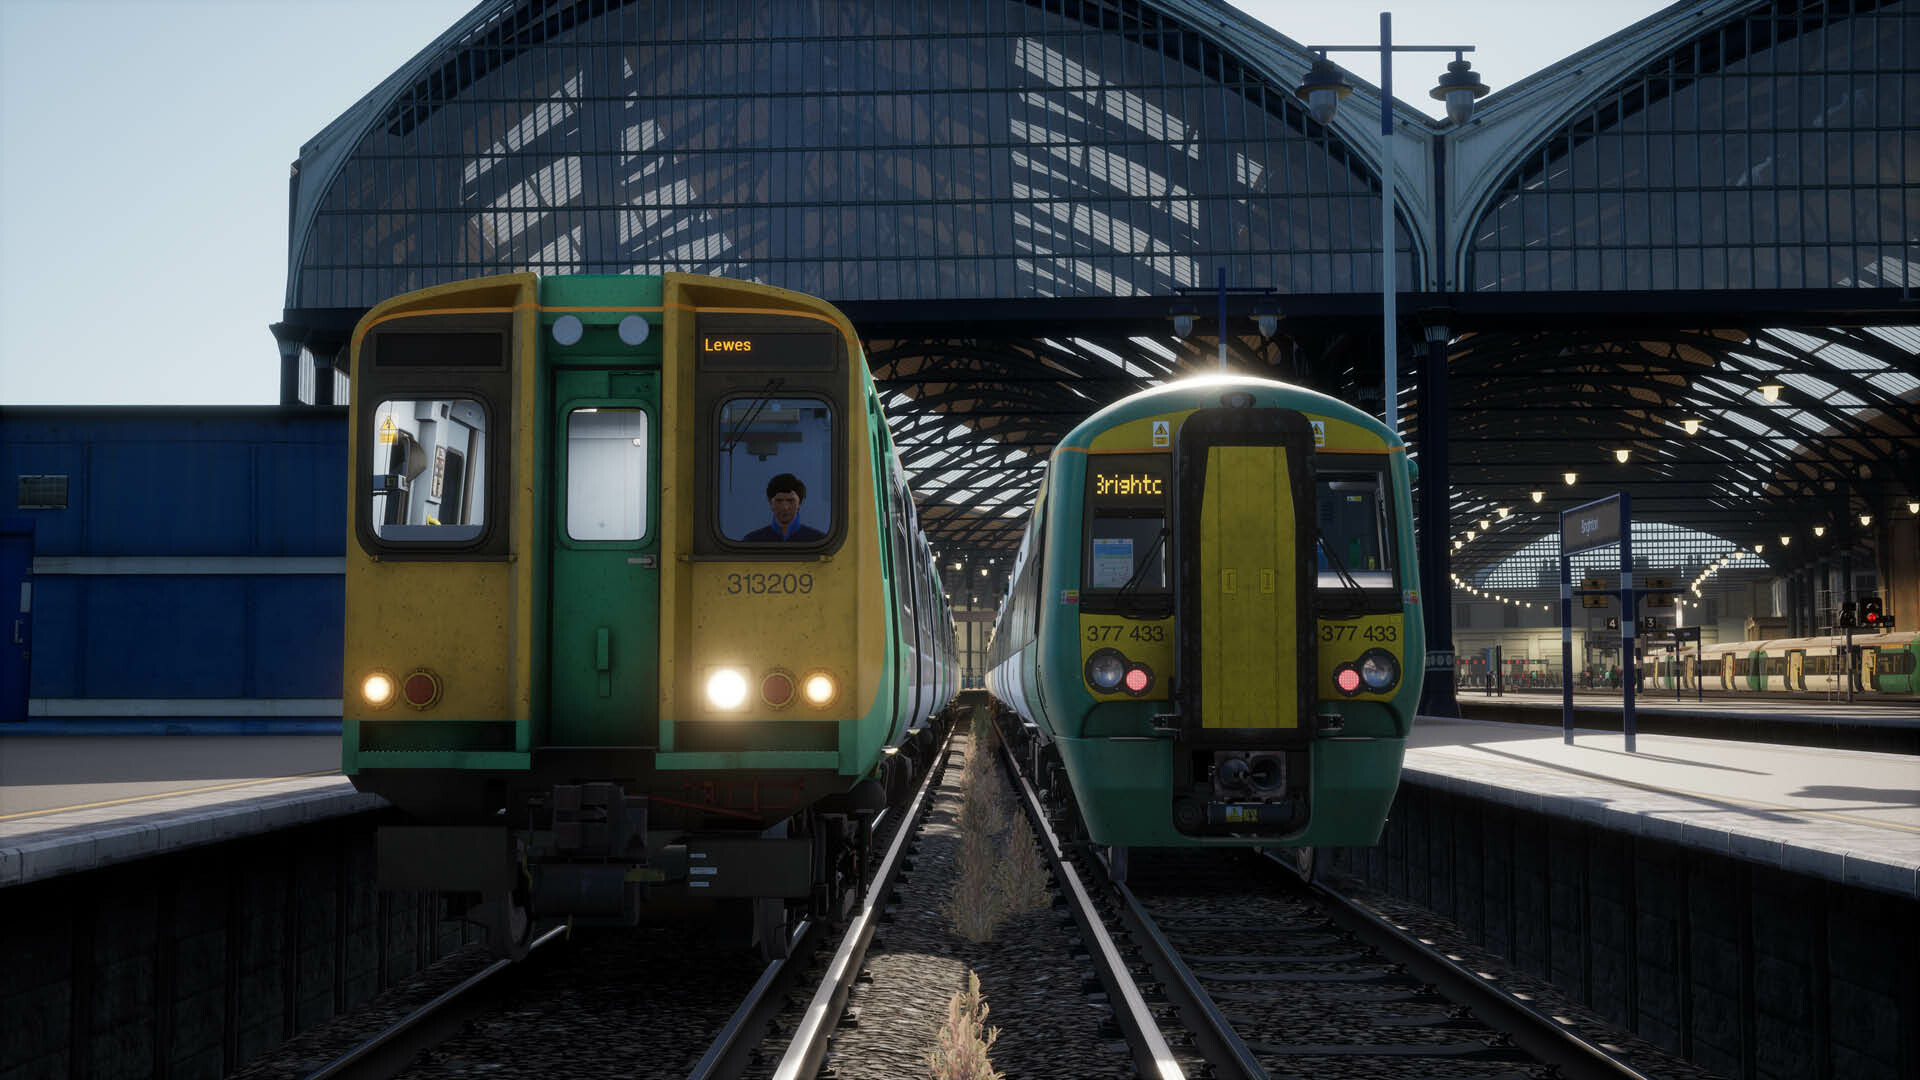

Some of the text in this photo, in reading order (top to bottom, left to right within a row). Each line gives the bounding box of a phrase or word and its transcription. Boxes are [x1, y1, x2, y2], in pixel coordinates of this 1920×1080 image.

[704, 339, 752, 352] Lewes
[727, 573, 814, 594] 313209
[1087, 625, 1164, 642] 377 433
[1321, 625, 1397, 642] 377 433
